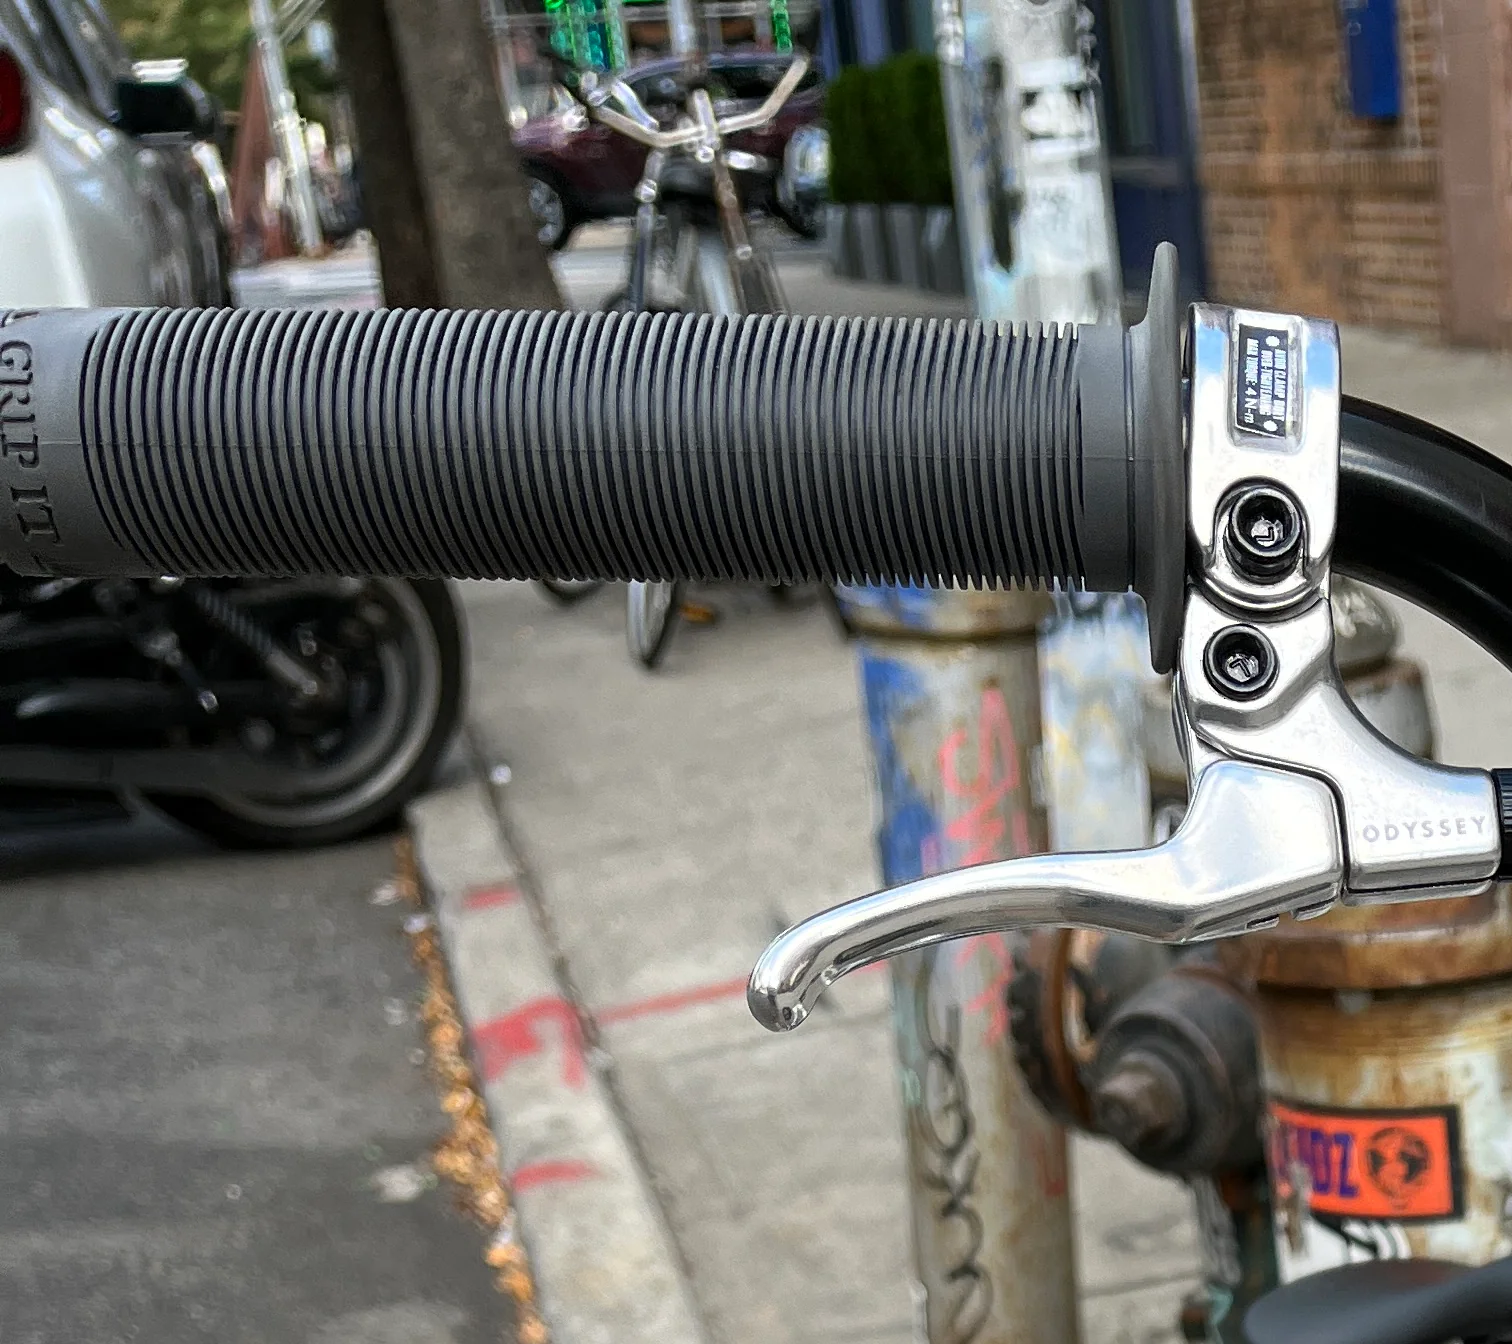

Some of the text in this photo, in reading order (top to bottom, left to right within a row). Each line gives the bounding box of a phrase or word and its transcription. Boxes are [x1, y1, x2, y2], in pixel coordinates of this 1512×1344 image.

[1245, 387, 1257, 395] 4
[1273, 371, 1287, 398] CLAMP
[0, 340, 61, 545] GRIP IT
[1363, 816, 1485, 843] ODYSSEY
